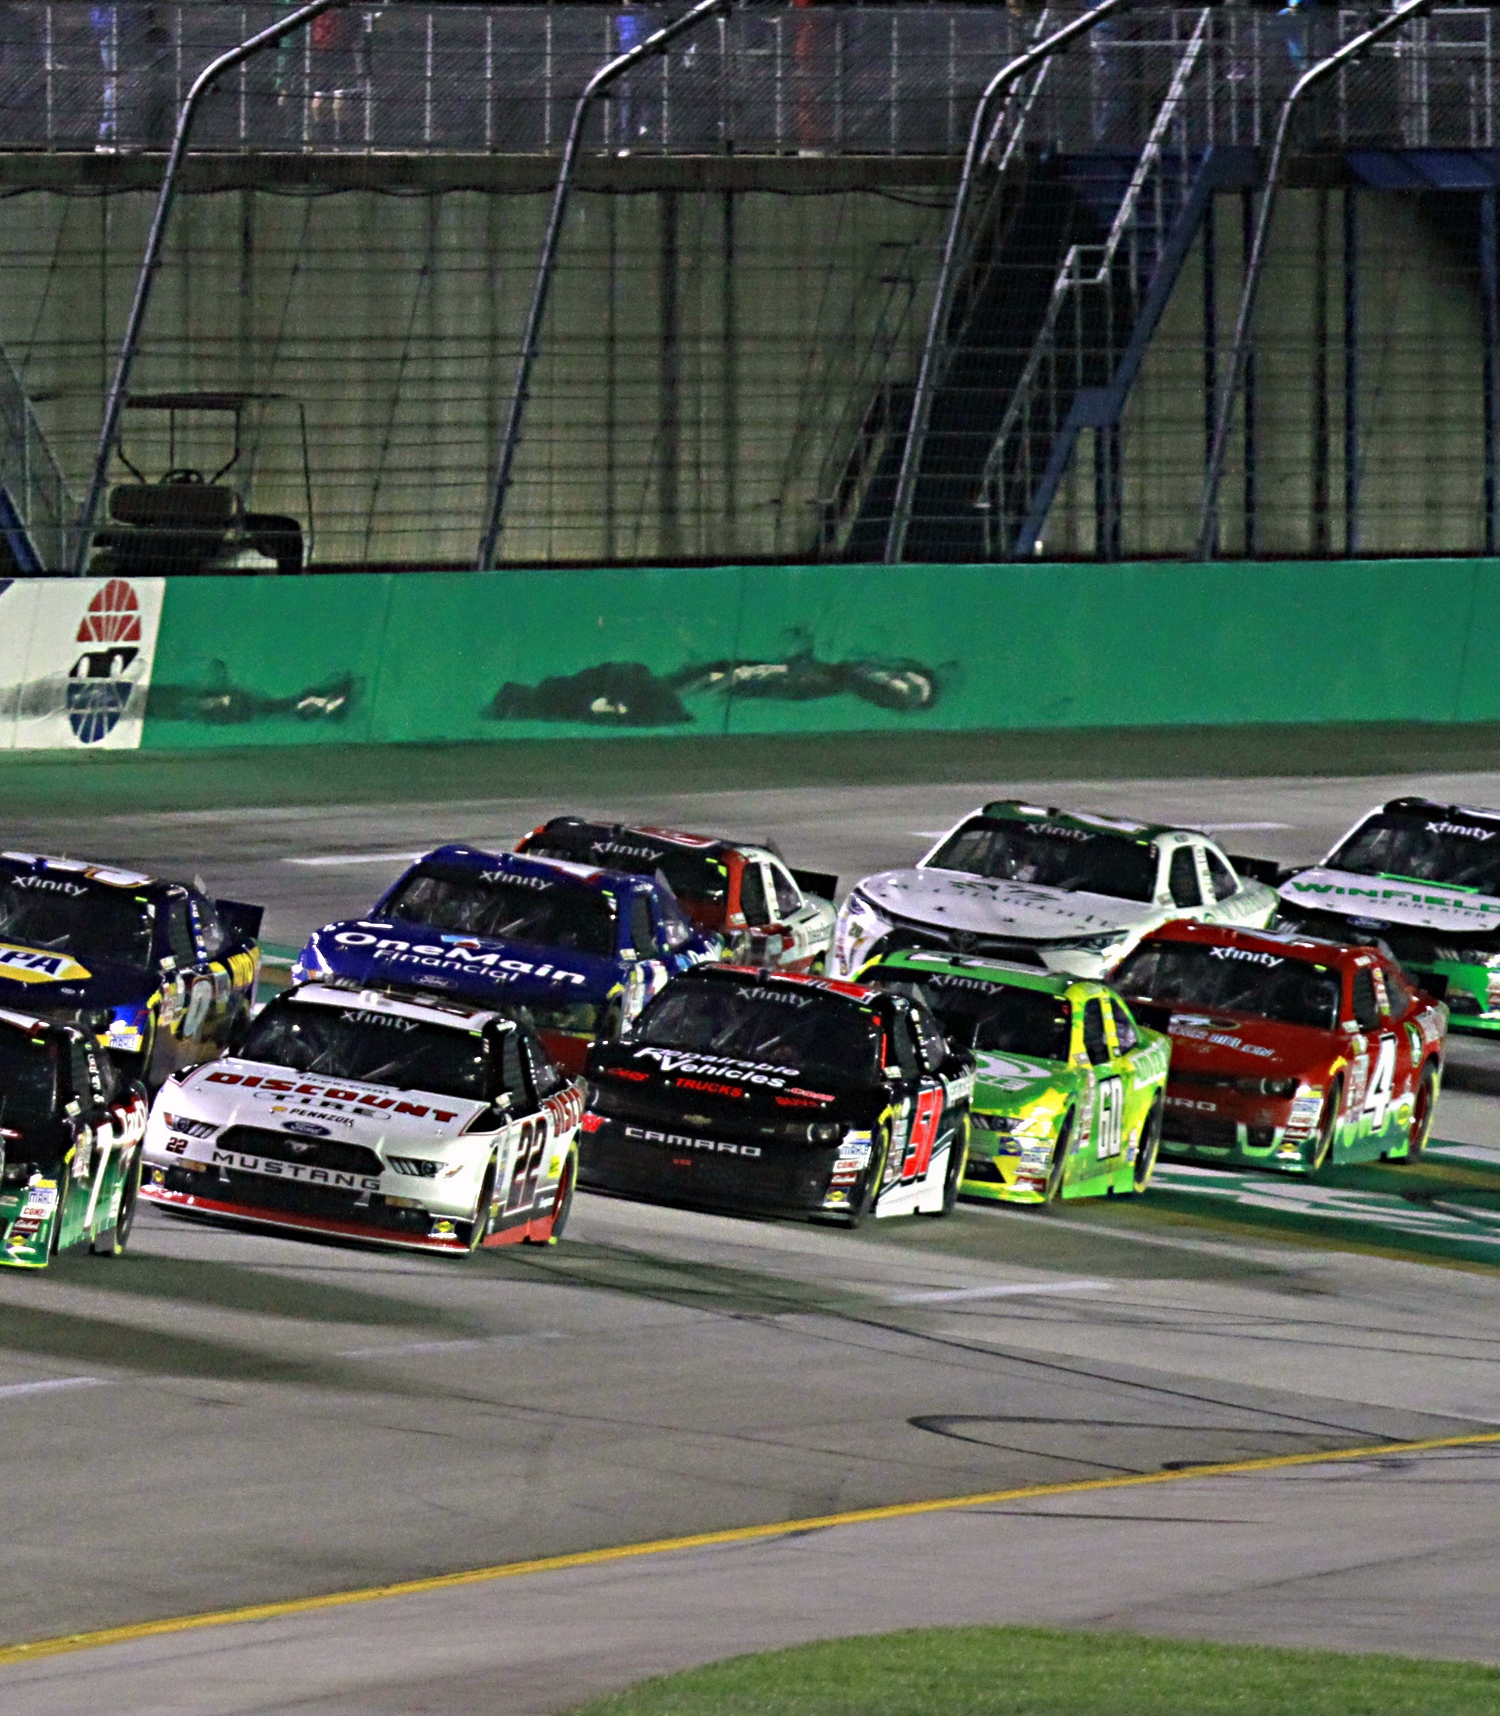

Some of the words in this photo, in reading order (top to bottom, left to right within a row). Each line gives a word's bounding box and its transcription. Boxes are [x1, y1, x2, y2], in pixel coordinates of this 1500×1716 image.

[1025, 821, 1097, 842] xfinity
[1425, 821, 1496, 841] xfinity
[590, 841, 664, 860] xfinity
[12, 875, 89, 896] xfinity
[479, 869, 555, 890] xfinity
[333, 931, 587, 985] OneMain
[372, 949, 521, 983] Financial
[1210, 946, 1285, 967] xfinity
[928, 973, 1005, 994] xfinity
[736, 987, 813, 1008] xfinity
[341, 1009, 420, 1031] xfinity
[633, 1047, 800, 1076] Repairable
[660, 1056, 787, 1089] Vehicles
[674, 1077, 744, 1098] TRUCKS
[1364, 1032, 1398, 1134] 4
[204, 1071, 459, 1123] DISCOUNT
[268, 1092, 381, 1118] TIRE
[165, 1137, 189, 1155] 22
[625, 1126, 762, 1157] CAMARO
[902, 1086, 944, 1187] 51
[212, 1150, 382, 1192] MUSTANG
[504, 1115, 548, 1214] 22
